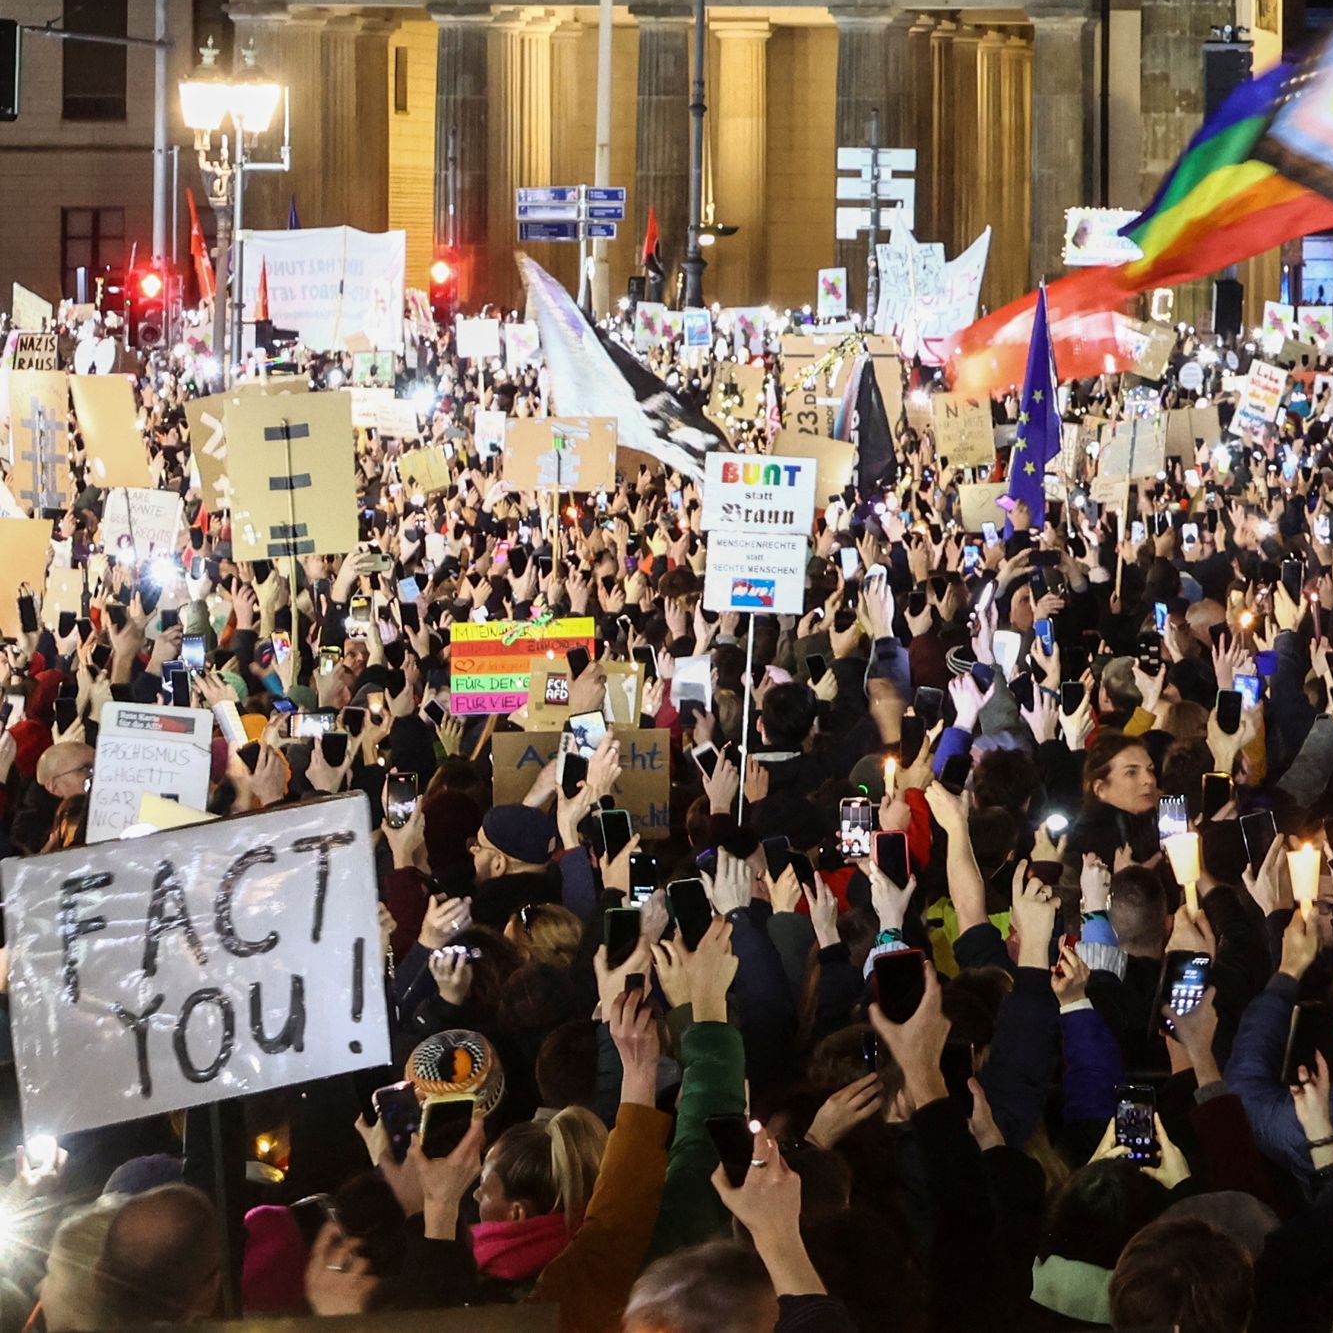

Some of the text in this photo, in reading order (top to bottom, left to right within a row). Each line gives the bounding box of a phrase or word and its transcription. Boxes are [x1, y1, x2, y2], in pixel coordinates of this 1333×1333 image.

[19, 335, 56, 352] NAZIS
[722, 461, 801, 486] BUNT
[745, 492, 773, 500] statt
[720, 502, 795, 524] Braun
[716, 538, 797, 550] MENSCHENRECHTE
[746, 553, 764, 561] statt
[714, 564, 798, 575] RECHTE MENSCHEN!
[455, 676, 486, 691] FÜR
[547, 679, 568, 689] FCK
[545, 689, 568, 700] AFD
[101, 742, 190, 766] FASCHISMUS
[96, 789, 135, 808] GAR
[91, 809, 136, 827] NICH
[60, 830, 356, 1004] FACT
